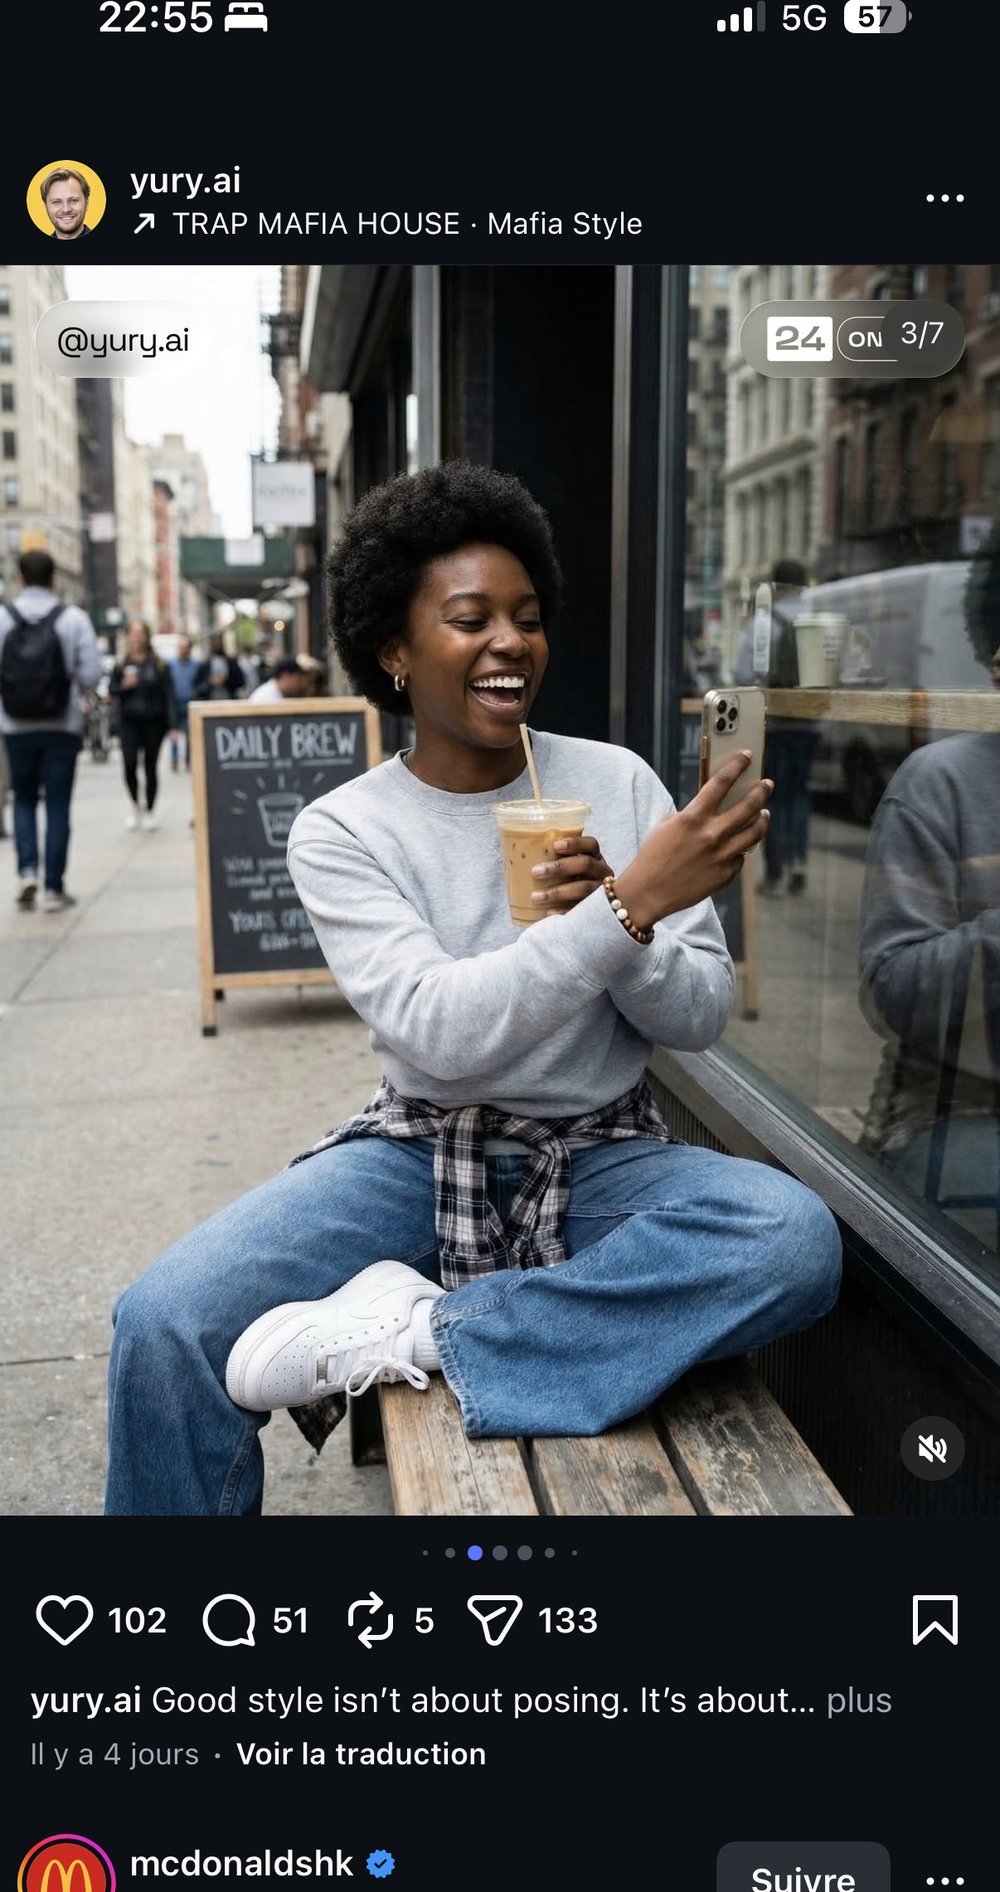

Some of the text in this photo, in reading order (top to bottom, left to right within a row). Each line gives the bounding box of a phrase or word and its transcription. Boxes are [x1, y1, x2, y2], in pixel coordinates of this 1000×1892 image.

[98, 0, 214, 34] 22:55
[782, 3, 827, 32] 5G
[857, 5, 893, 28] 57
[129, 164, 241, 200] yury.ai
[172, 210, 643, 241] TRAP MAFIA HOUSE Mafia Style
[215, 721, 358, 761] DAILY BREW
[108, 1606, 167, 1635] 102
[272, 1606, 307, 1635] 51
[414, 1606, 435, 1635] 5
[538, 1606, 598, 1635] 133
[30, 1684, 141, 1720] yury.ai
[152, 1685, 236, 1714] Good
[248, 1685, 324, 1720] style
[334, 1685, 401, 1714] isn’t
[411, 1685, 503, 1714] about
[514, 1685, 629, 1720] posing.
[641, 1685, 687, 1714] It’s
[827, 1685, 892, 1720] plus
[31, 1740, 486, 1771] Il y a 4 jours Voir la traduction
[131, 1848, 355, 1877] mcdonaldshk
[751, 1866, 856, 1892] Suivre
